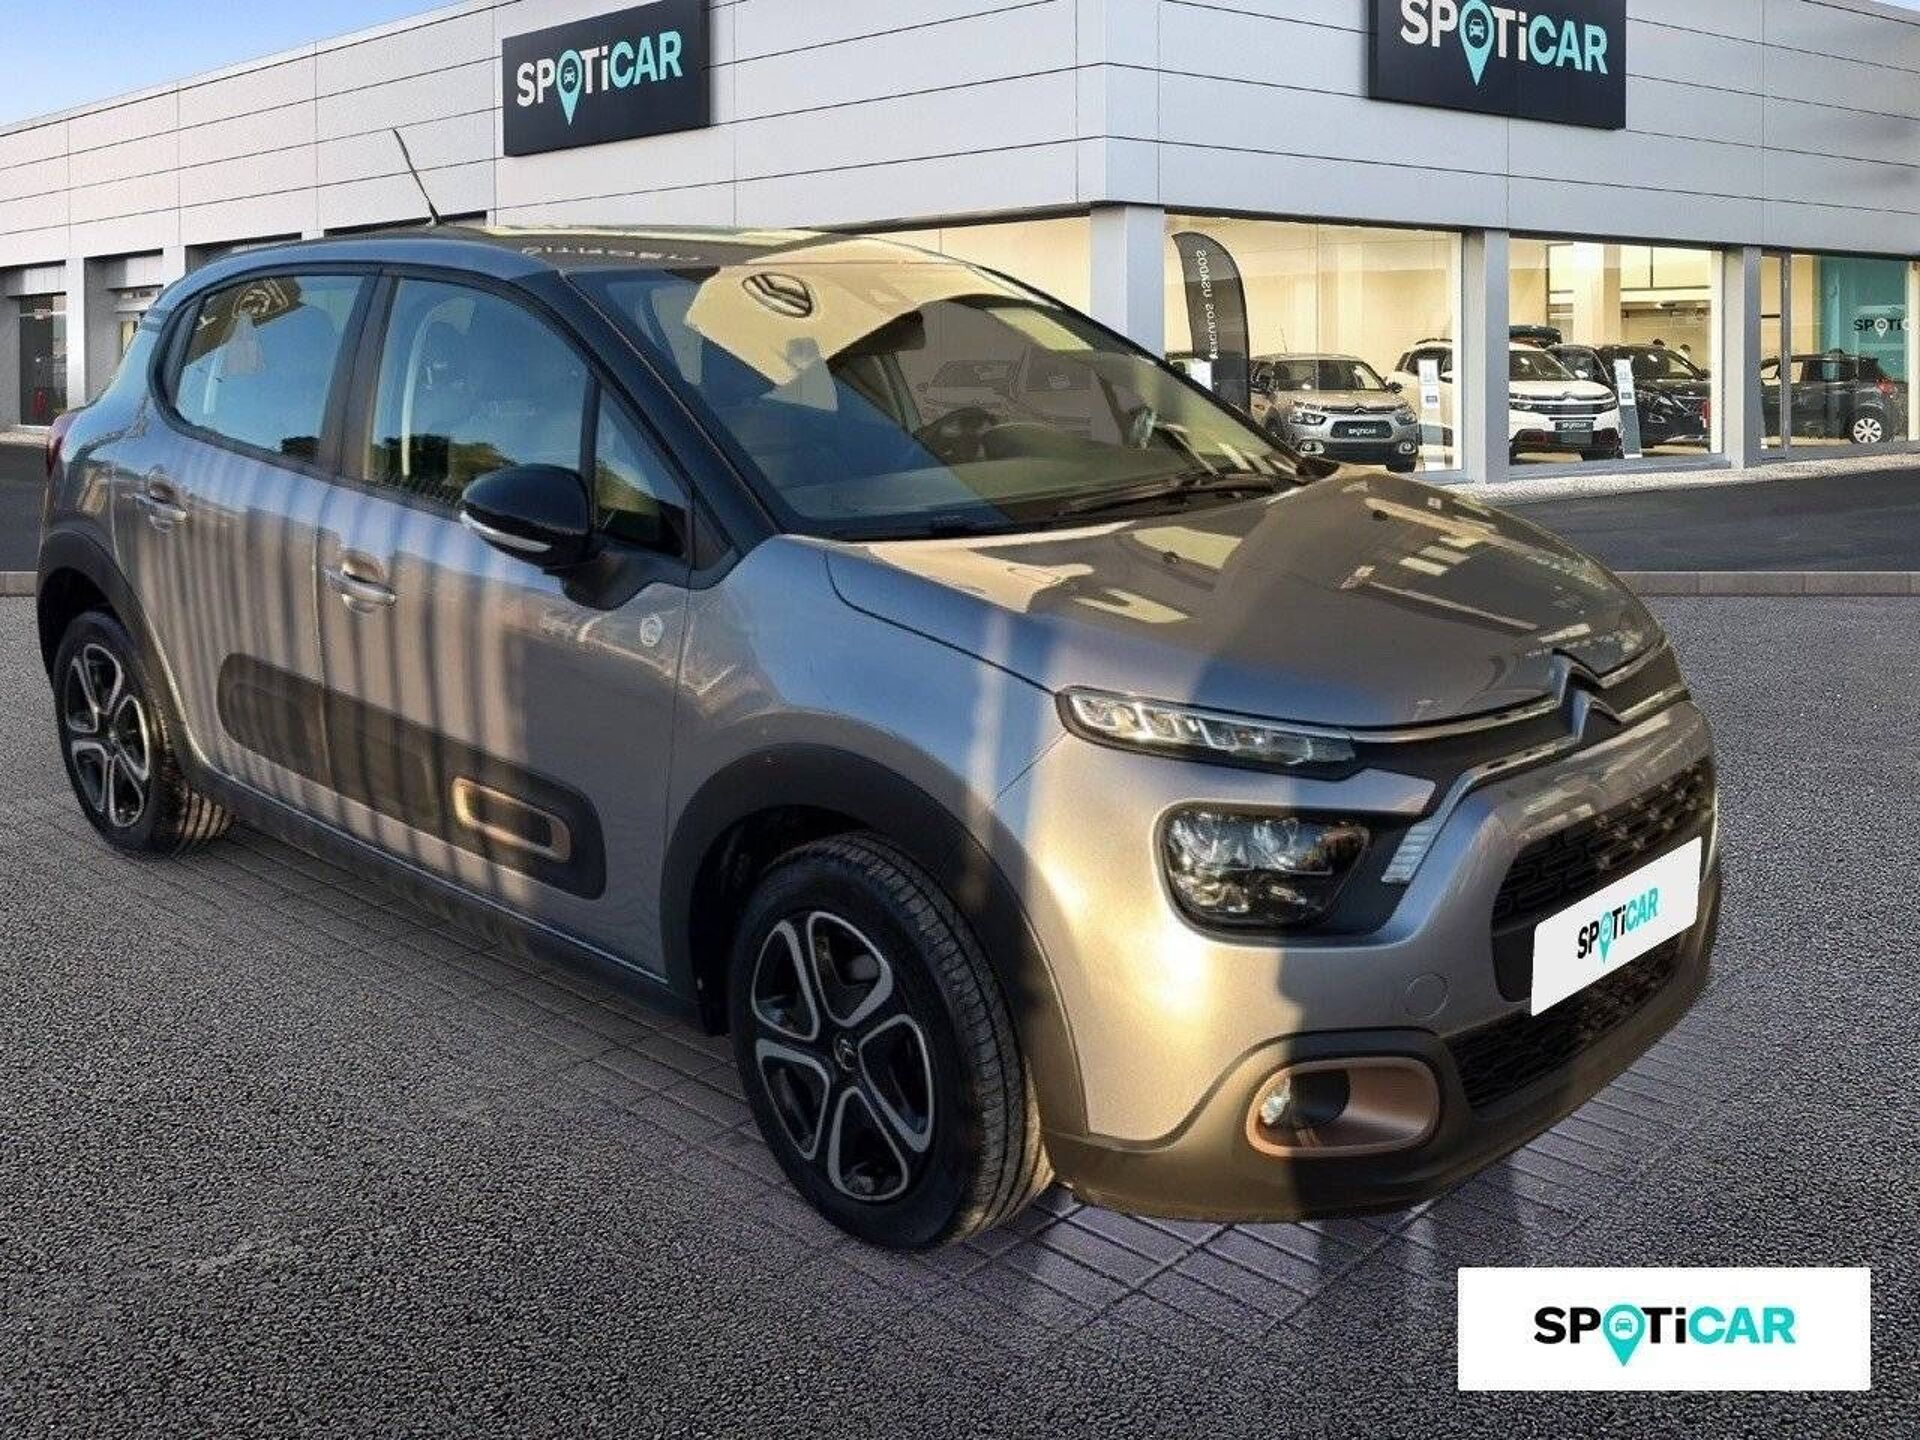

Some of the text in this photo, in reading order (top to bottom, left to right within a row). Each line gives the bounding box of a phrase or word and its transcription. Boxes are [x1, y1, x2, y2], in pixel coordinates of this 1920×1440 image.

[516, 30, 683, 126] SPOTiCAR
[1400, 0, 1608, 86] SPOTiCAR
[1577, 887, 1659, 963] SPOTiCAR
